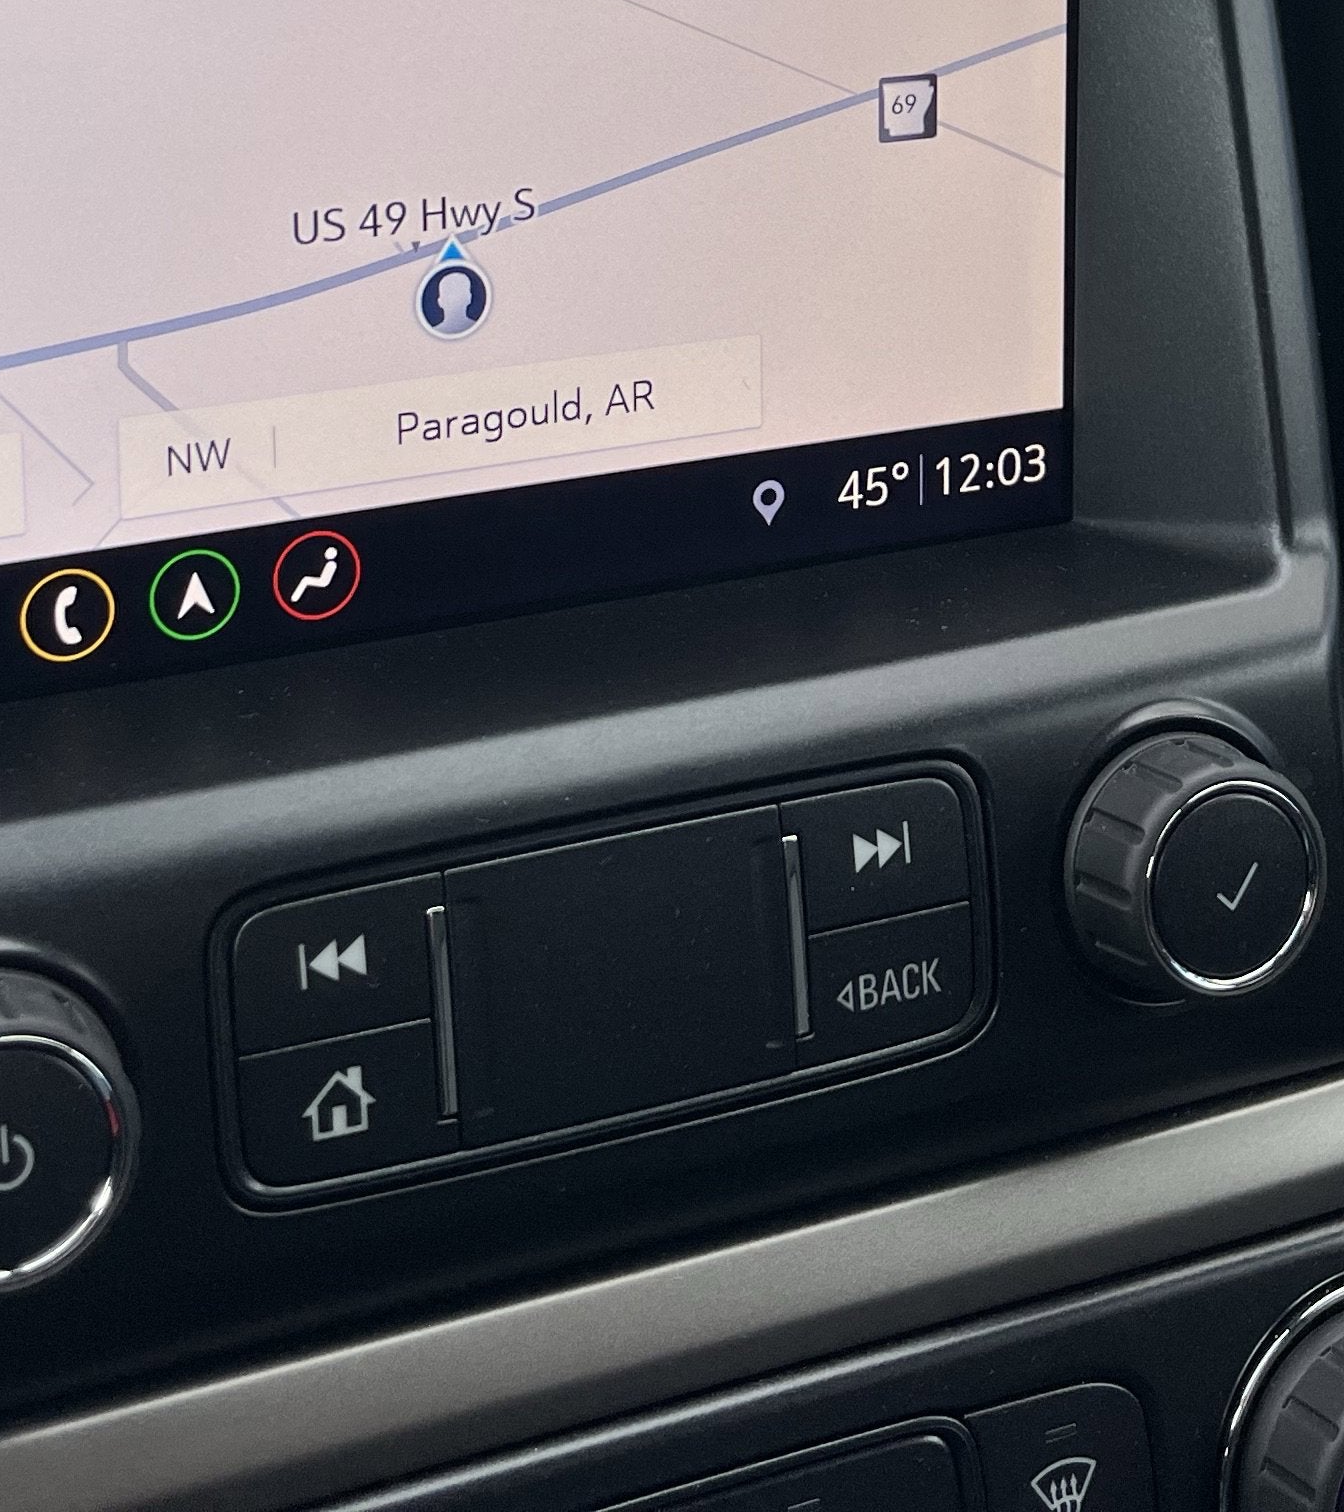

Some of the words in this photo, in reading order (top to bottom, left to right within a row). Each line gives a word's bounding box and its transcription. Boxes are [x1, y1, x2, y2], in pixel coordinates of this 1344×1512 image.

[890, 94, 918, 116] 69
[292, 208, 347, 245] US
[359, 201, 407, 238] 49
[420, 196, 502, 235] Hwy
[512, 187, 537, 221] S
[396, 387, 593, 445] Paragould,
[604, 379, 656, 417] AR
[166, 437, 231, 477] NW
[933, 442, 1048, 498] 12:03
[836, 460, 910, 511] 45°
[857, 957, 942, 1012] BACK
